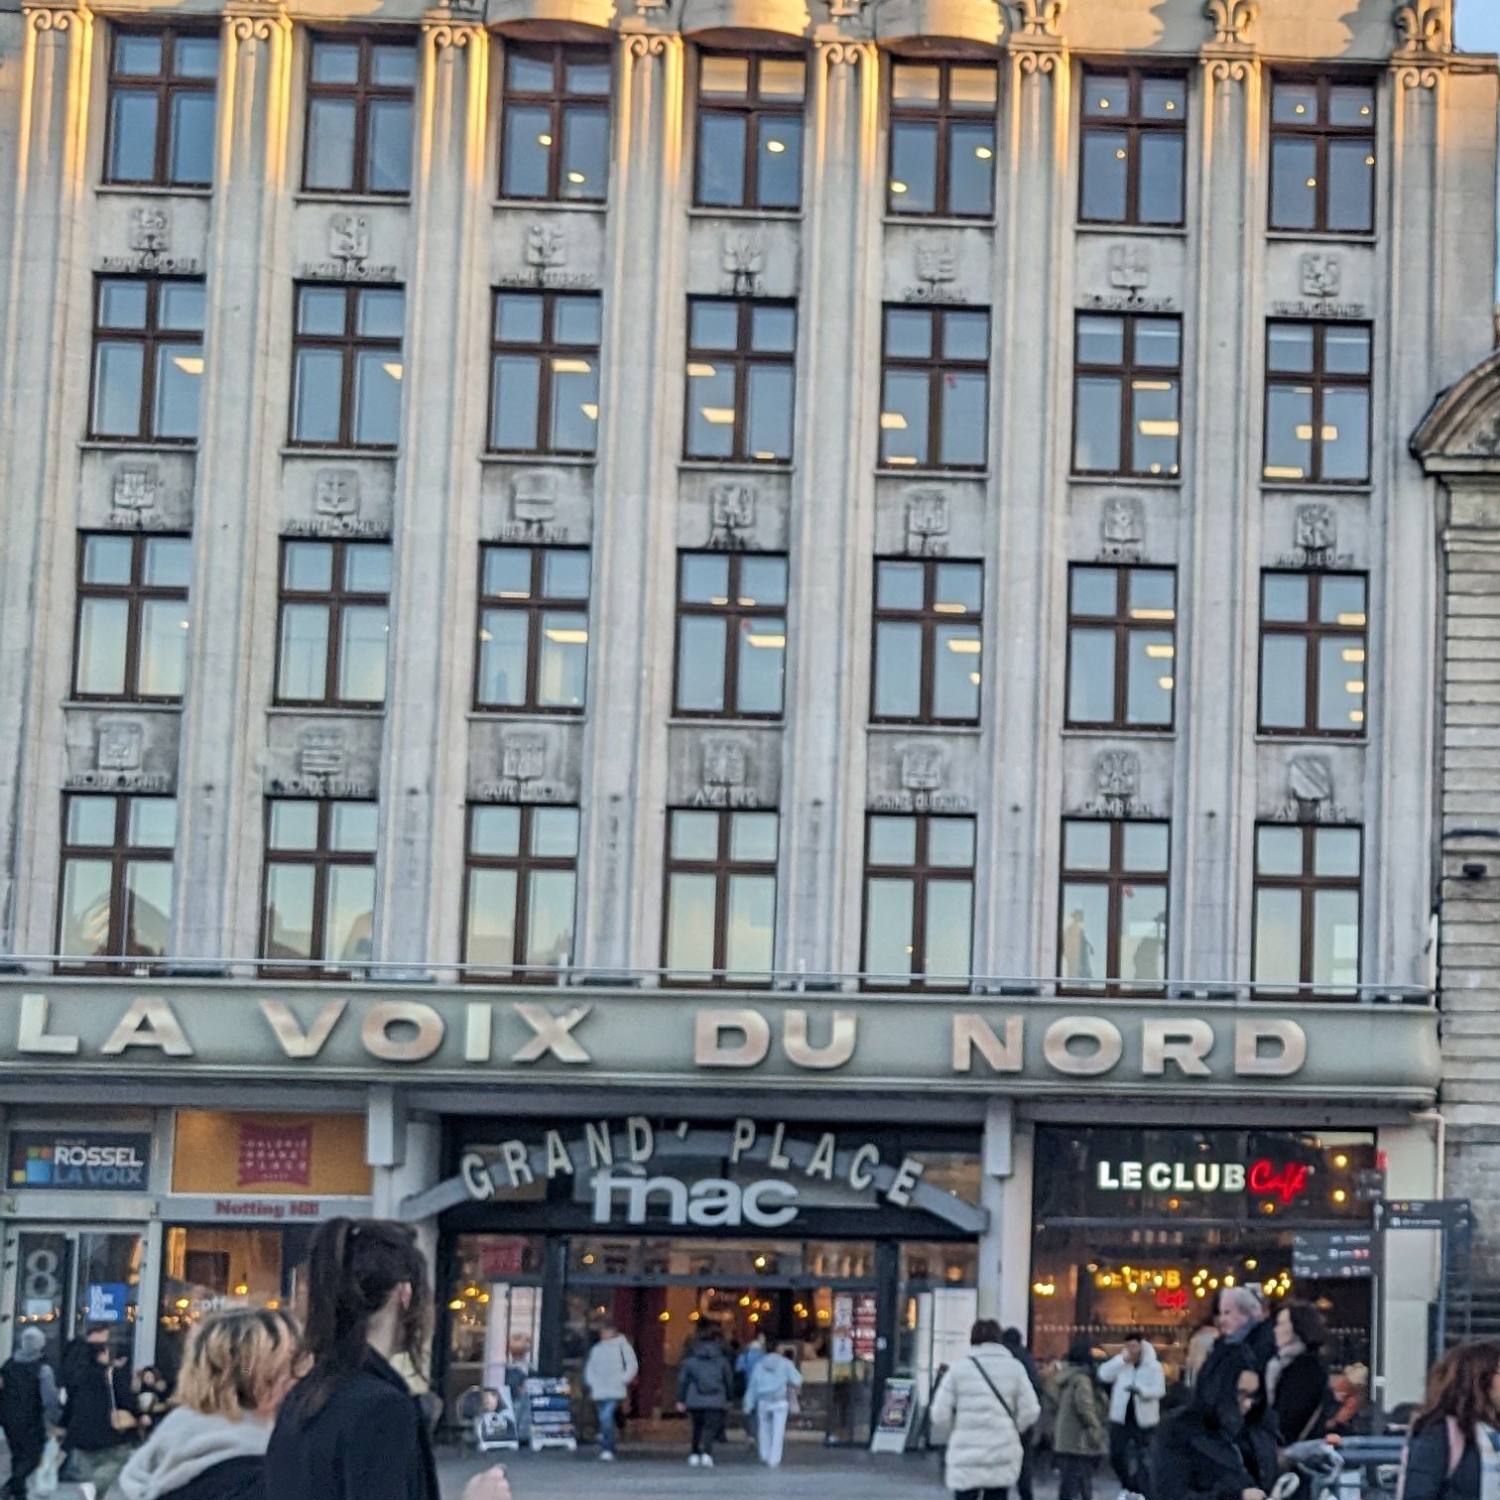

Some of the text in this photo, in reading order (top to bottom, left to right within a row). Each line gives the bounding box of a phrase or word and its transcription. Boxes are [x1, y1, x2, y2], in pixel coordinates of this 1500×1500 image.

[17, 993, 1307, 1077] LA VOIX DU NORD
[54, 1145, 145, 1167] ROSSEL
[87, 1166, 142, 1185] VOIX
[1096, 1160, 1143, 1191] LE
[1147, 1161, 1246, 1192] CLUB
[590, 1163, 799, 1227] fnac
